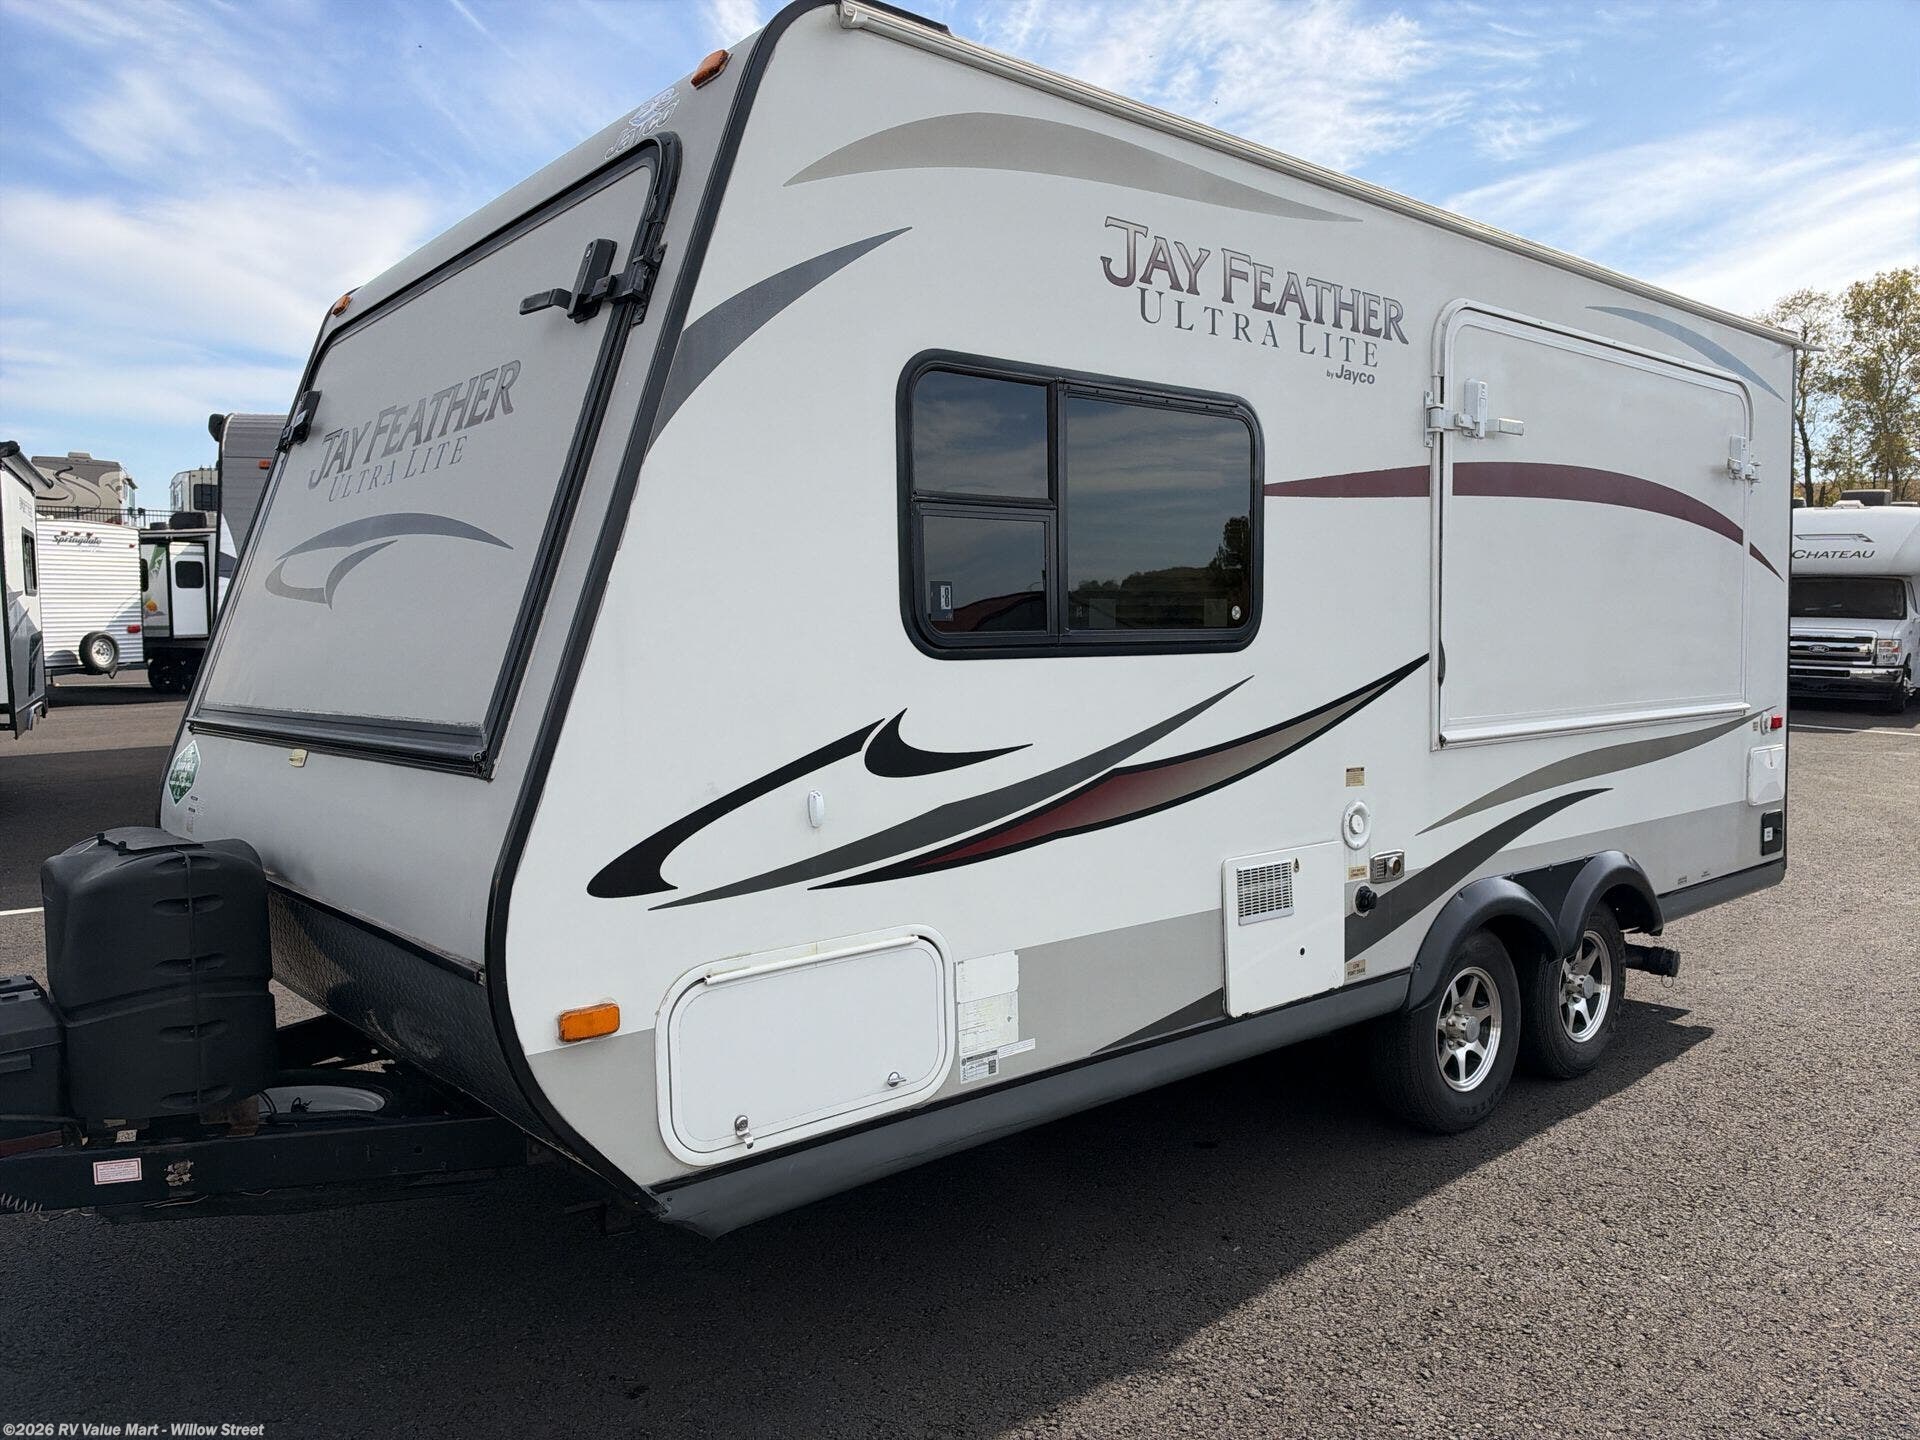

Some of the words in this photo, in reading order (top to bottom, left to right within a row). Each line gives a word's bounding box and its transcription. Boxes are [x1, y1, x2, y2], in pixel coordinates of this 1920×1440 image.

[1100, 216, 1210, 296] JAY
[1221, 247, 1409, 345] FEATHER
[1137, 286, 1280, 348] ULTRA
[1297, 321, 1378, 367] LITE
[1326, 369, 1334, 378] by
[1335, 364, 1375, 385] Jayco
[308, 420, 372, 489] JAY
[362, 359, 521, 465] FEATHER
[328, 460, 396, 502] ULTRA
[403, 435, 468, 480] LITE
[1791, 549, 1875, 560] CHATEAU
